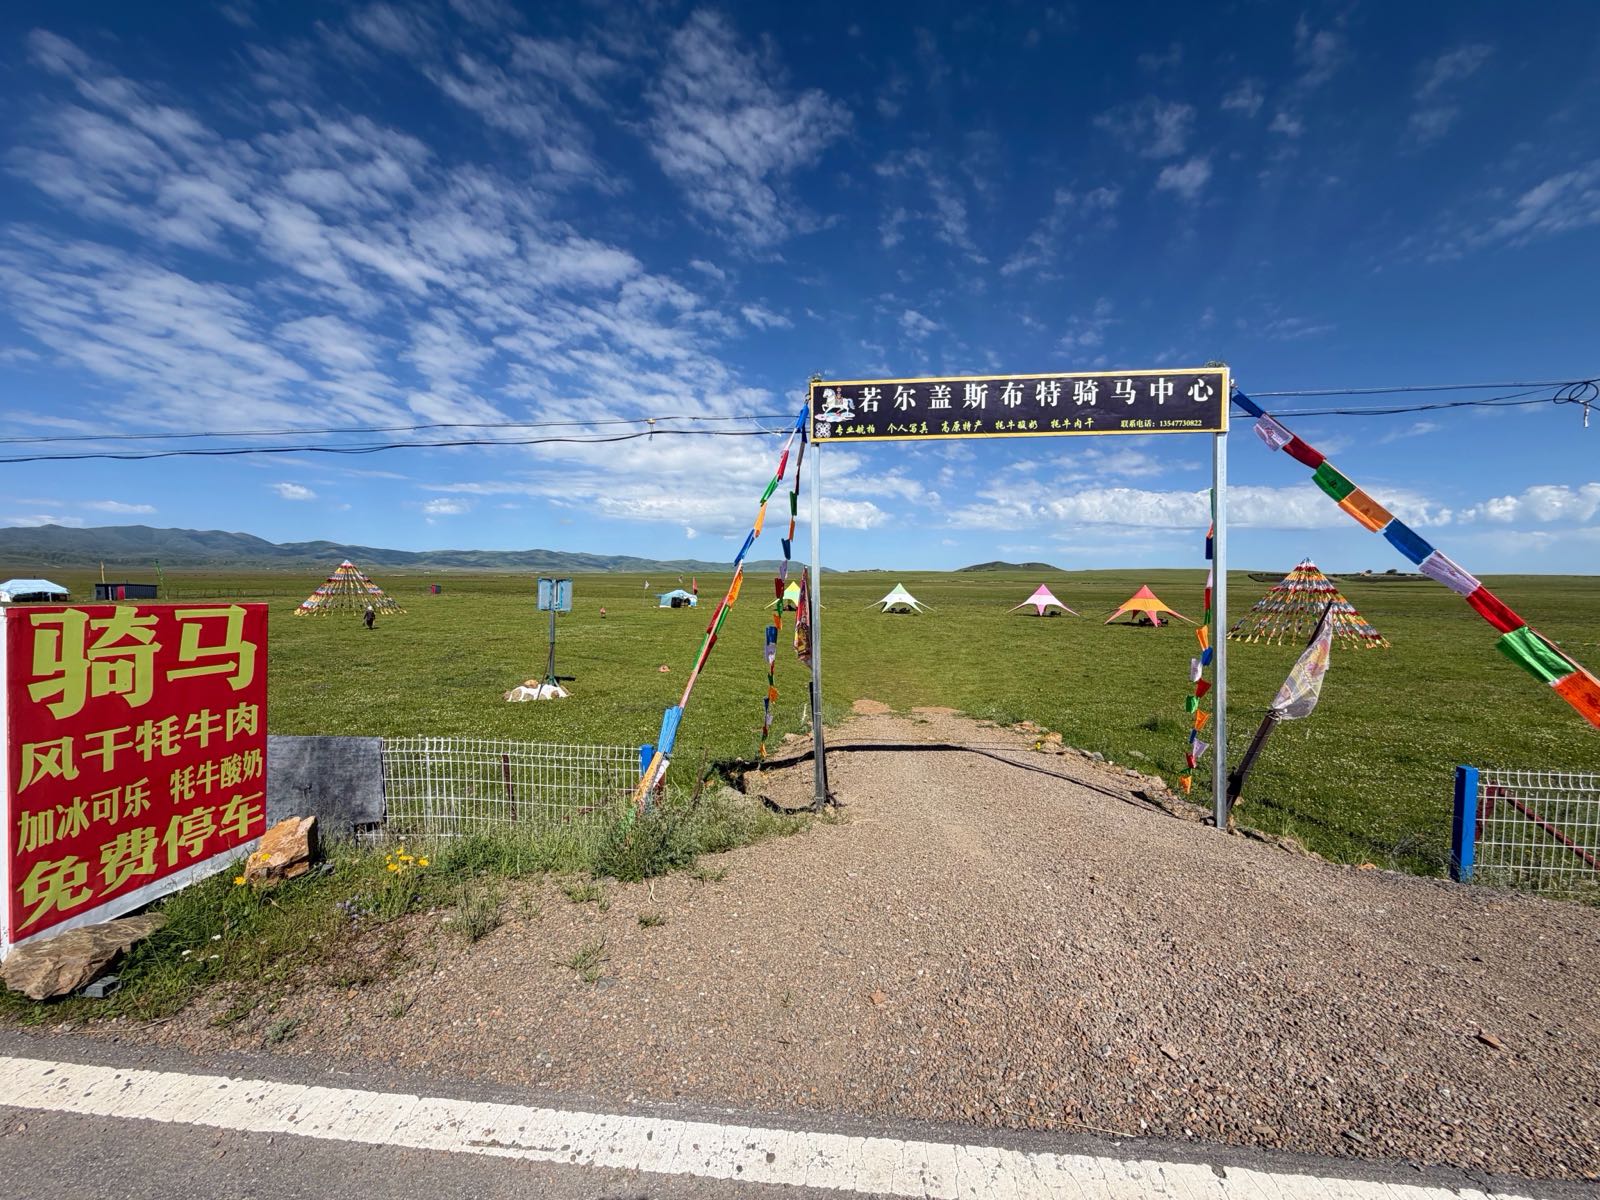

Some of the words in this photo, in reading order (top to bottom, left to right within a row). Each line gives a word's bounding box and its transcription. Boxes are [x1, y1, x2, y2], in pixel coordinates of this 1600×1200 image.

[857, 378, 1214, 413] 若尔盖斯布特骑马中心
[887, 420, 930, 435] 个人写真
[941, 419, 984, 434] 高原特产
[995, 418, 1039, 431] 牦牛酸奶
[1051, 417, 1095, 430] 牦牛肉干
[28, 603, 258, 720] 骑马
[17, 702, 259, 794] 风干牦牛肉
[17, 777, 152, 857] 加冰可乐
[170, 748, 264, 805] 牦牛酸奶
[16, 791, 265, 932] 免费停车
